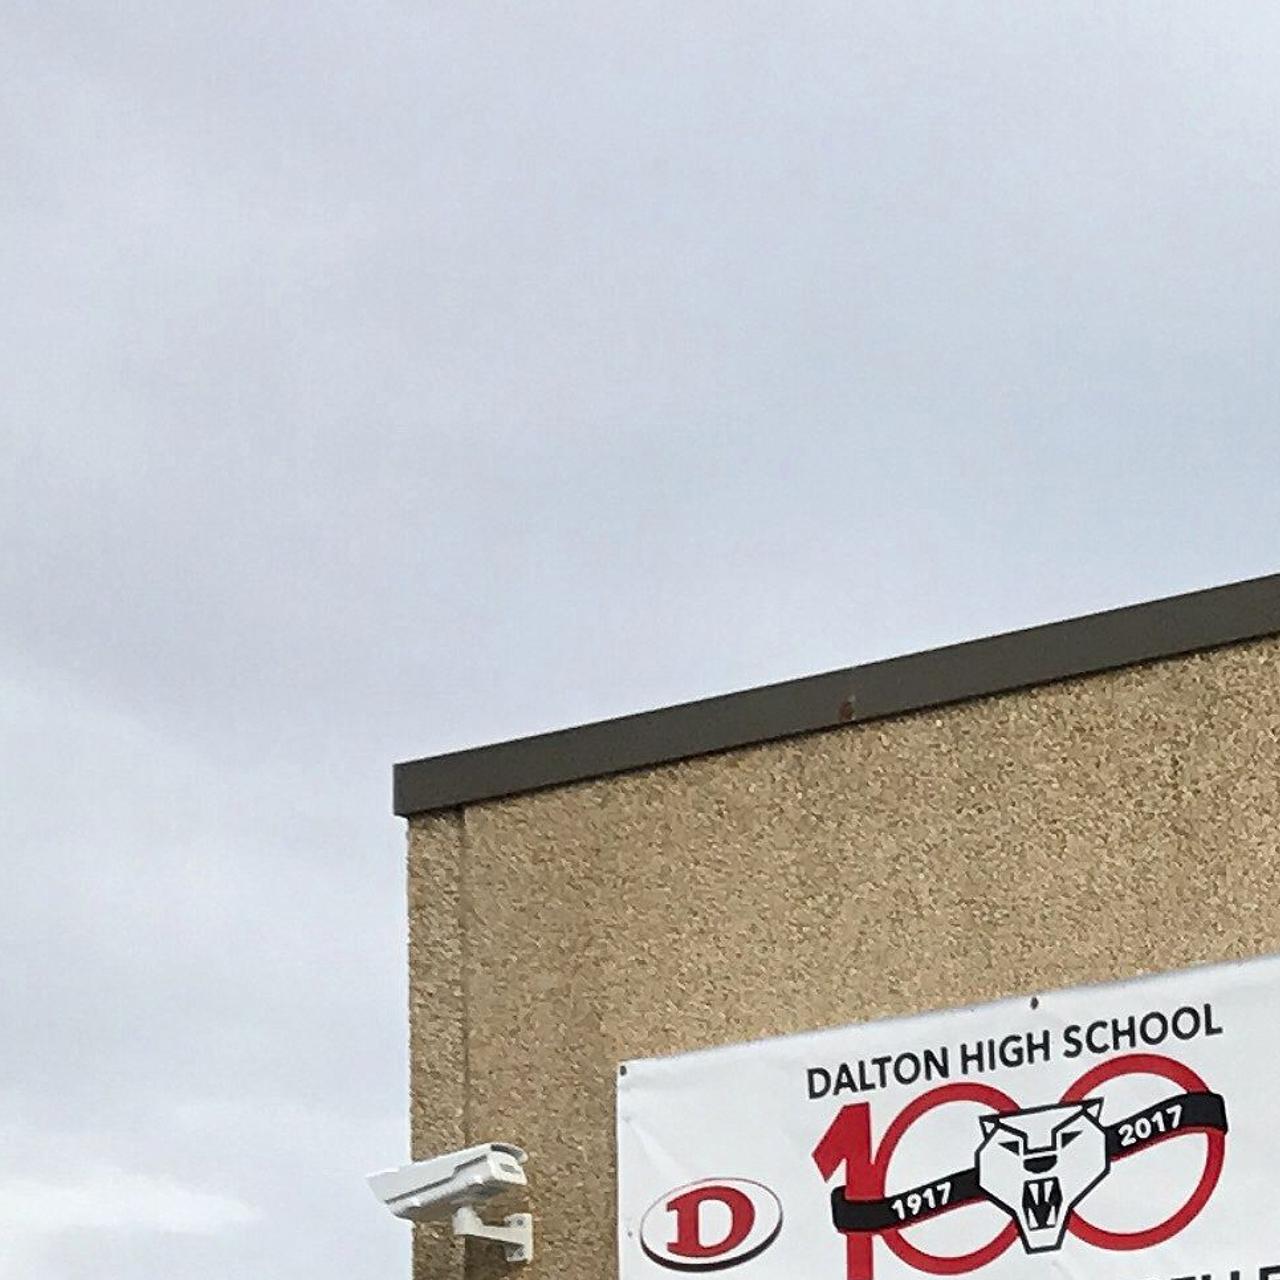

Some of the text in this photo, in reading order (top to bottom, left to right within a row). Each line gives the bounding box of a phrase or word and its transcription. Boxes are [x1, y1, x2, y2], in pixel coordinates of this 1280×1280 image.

[807, 1003, 1223, 1099] DALTON HIGH SCHOOL
[1118, 1105, 1183, 1147] 2017
[666, 1185, 756, 1258] D
[890, 1181, 952, 1221] 1917
